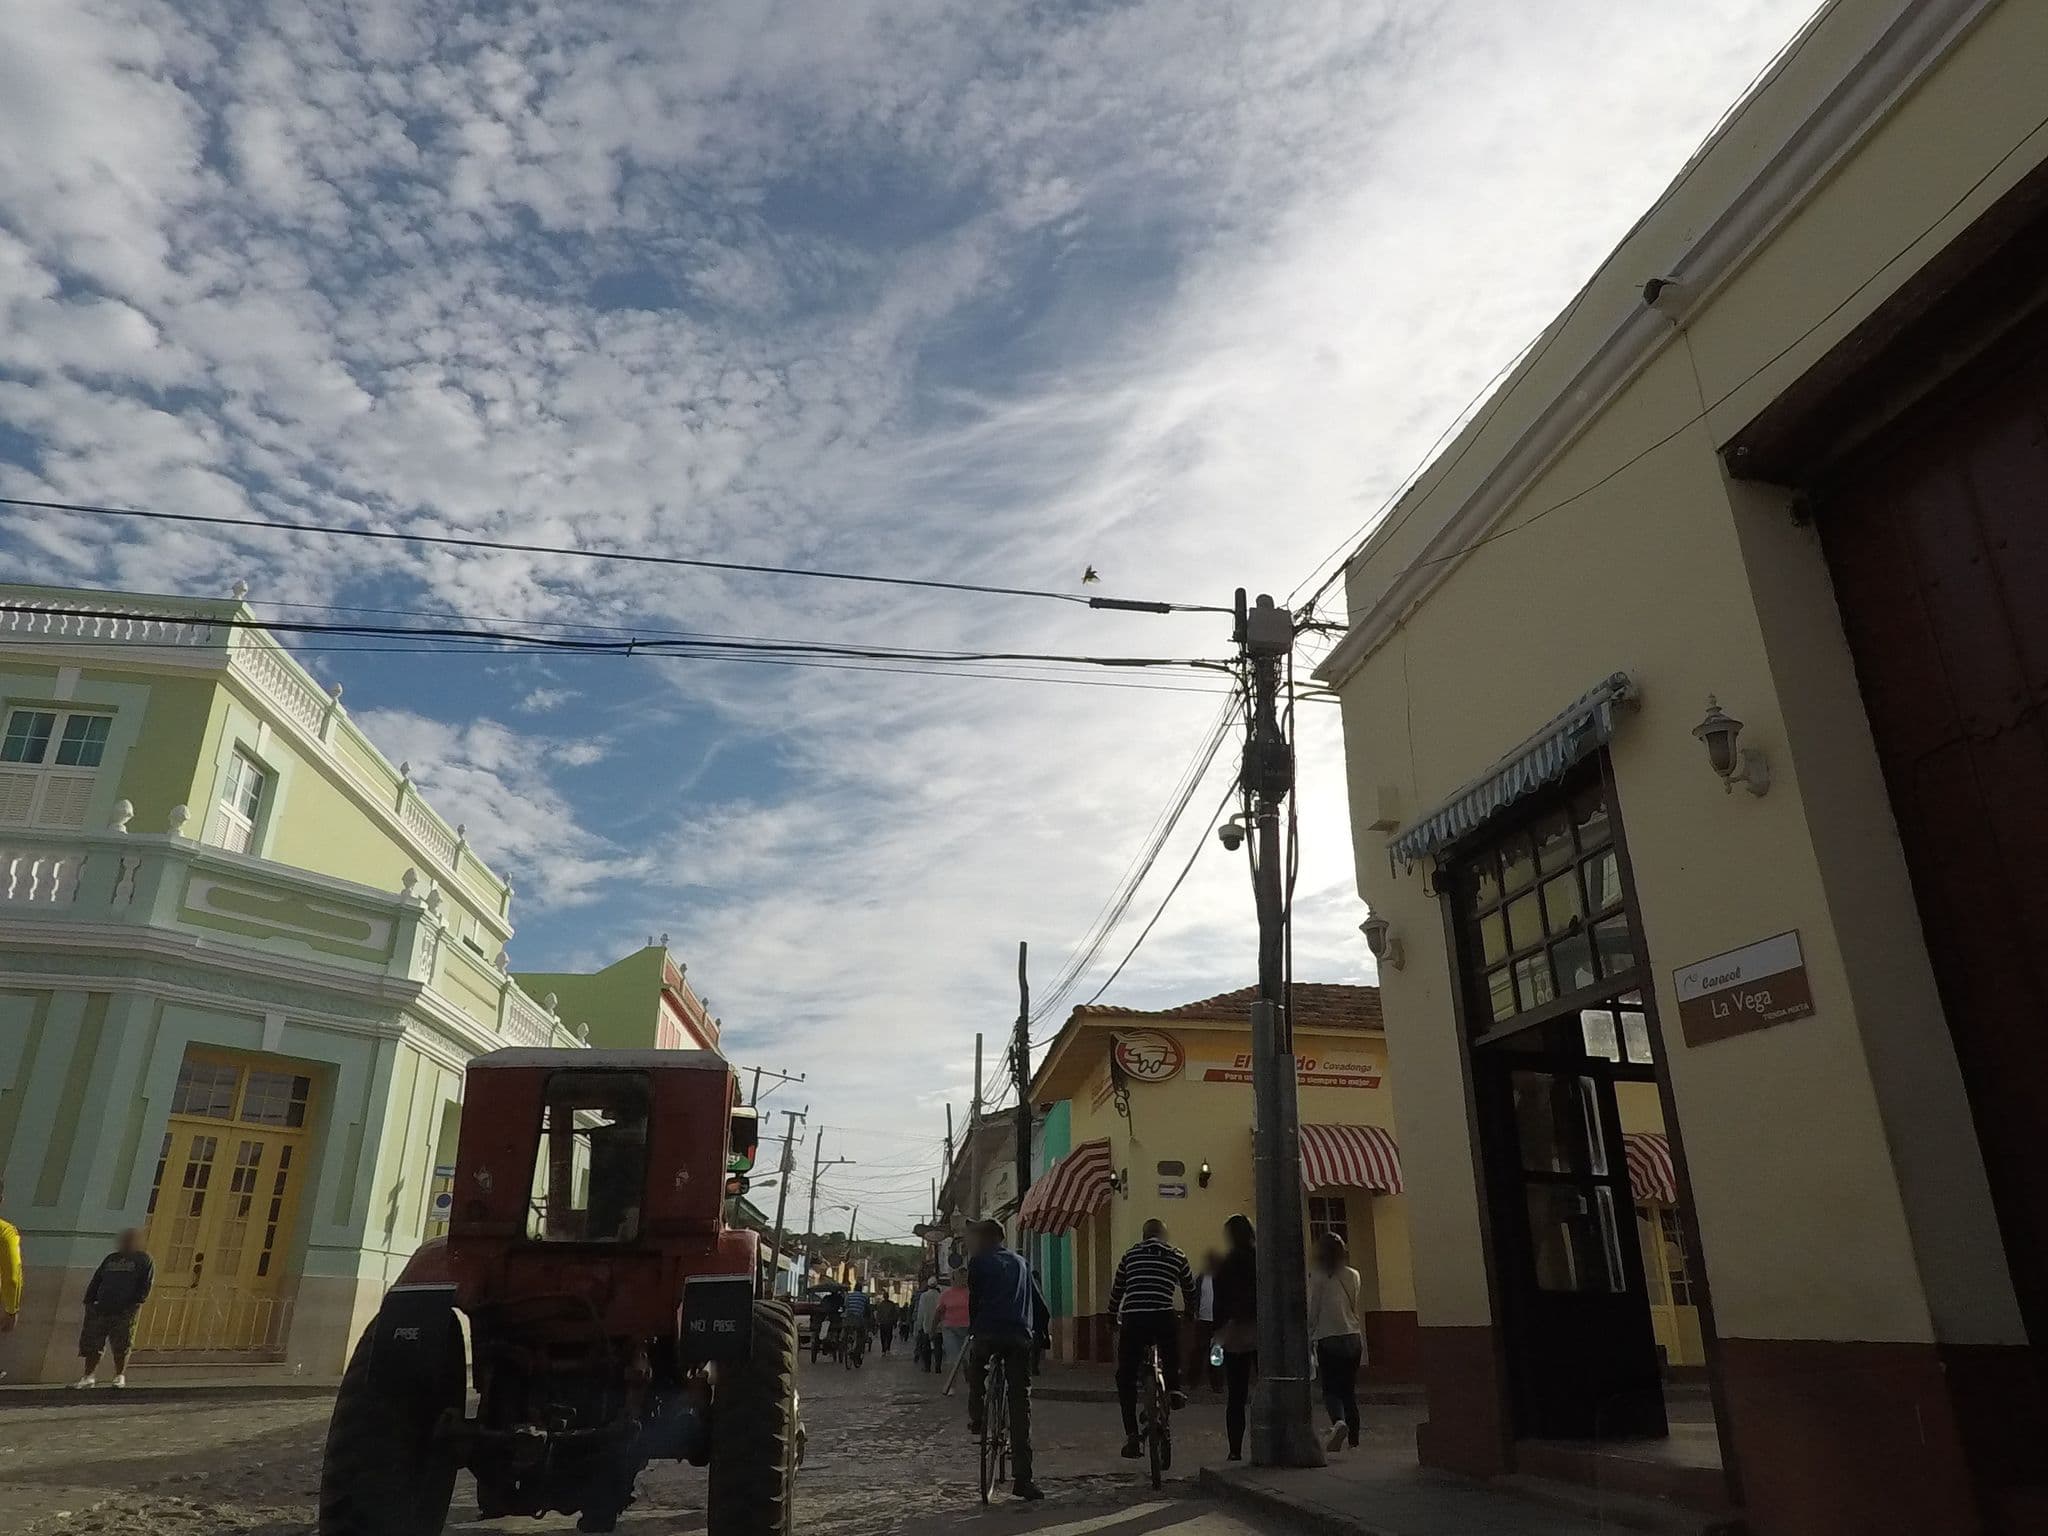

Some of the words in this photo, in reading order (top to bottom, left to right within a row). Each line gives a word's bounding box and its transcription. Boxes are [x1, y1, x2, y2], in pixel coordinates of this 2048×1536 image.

[1702, 966, 1742, 990] Caracol
[1710, 1000, 1730, 1019] La
[1732, 990, 1773, 1014] Vega
[1233, 1054, 1252, 1068] El
[1323, 1061, 1372, 1074] Covadonga
[690, 1319, 706, 1333] NO
